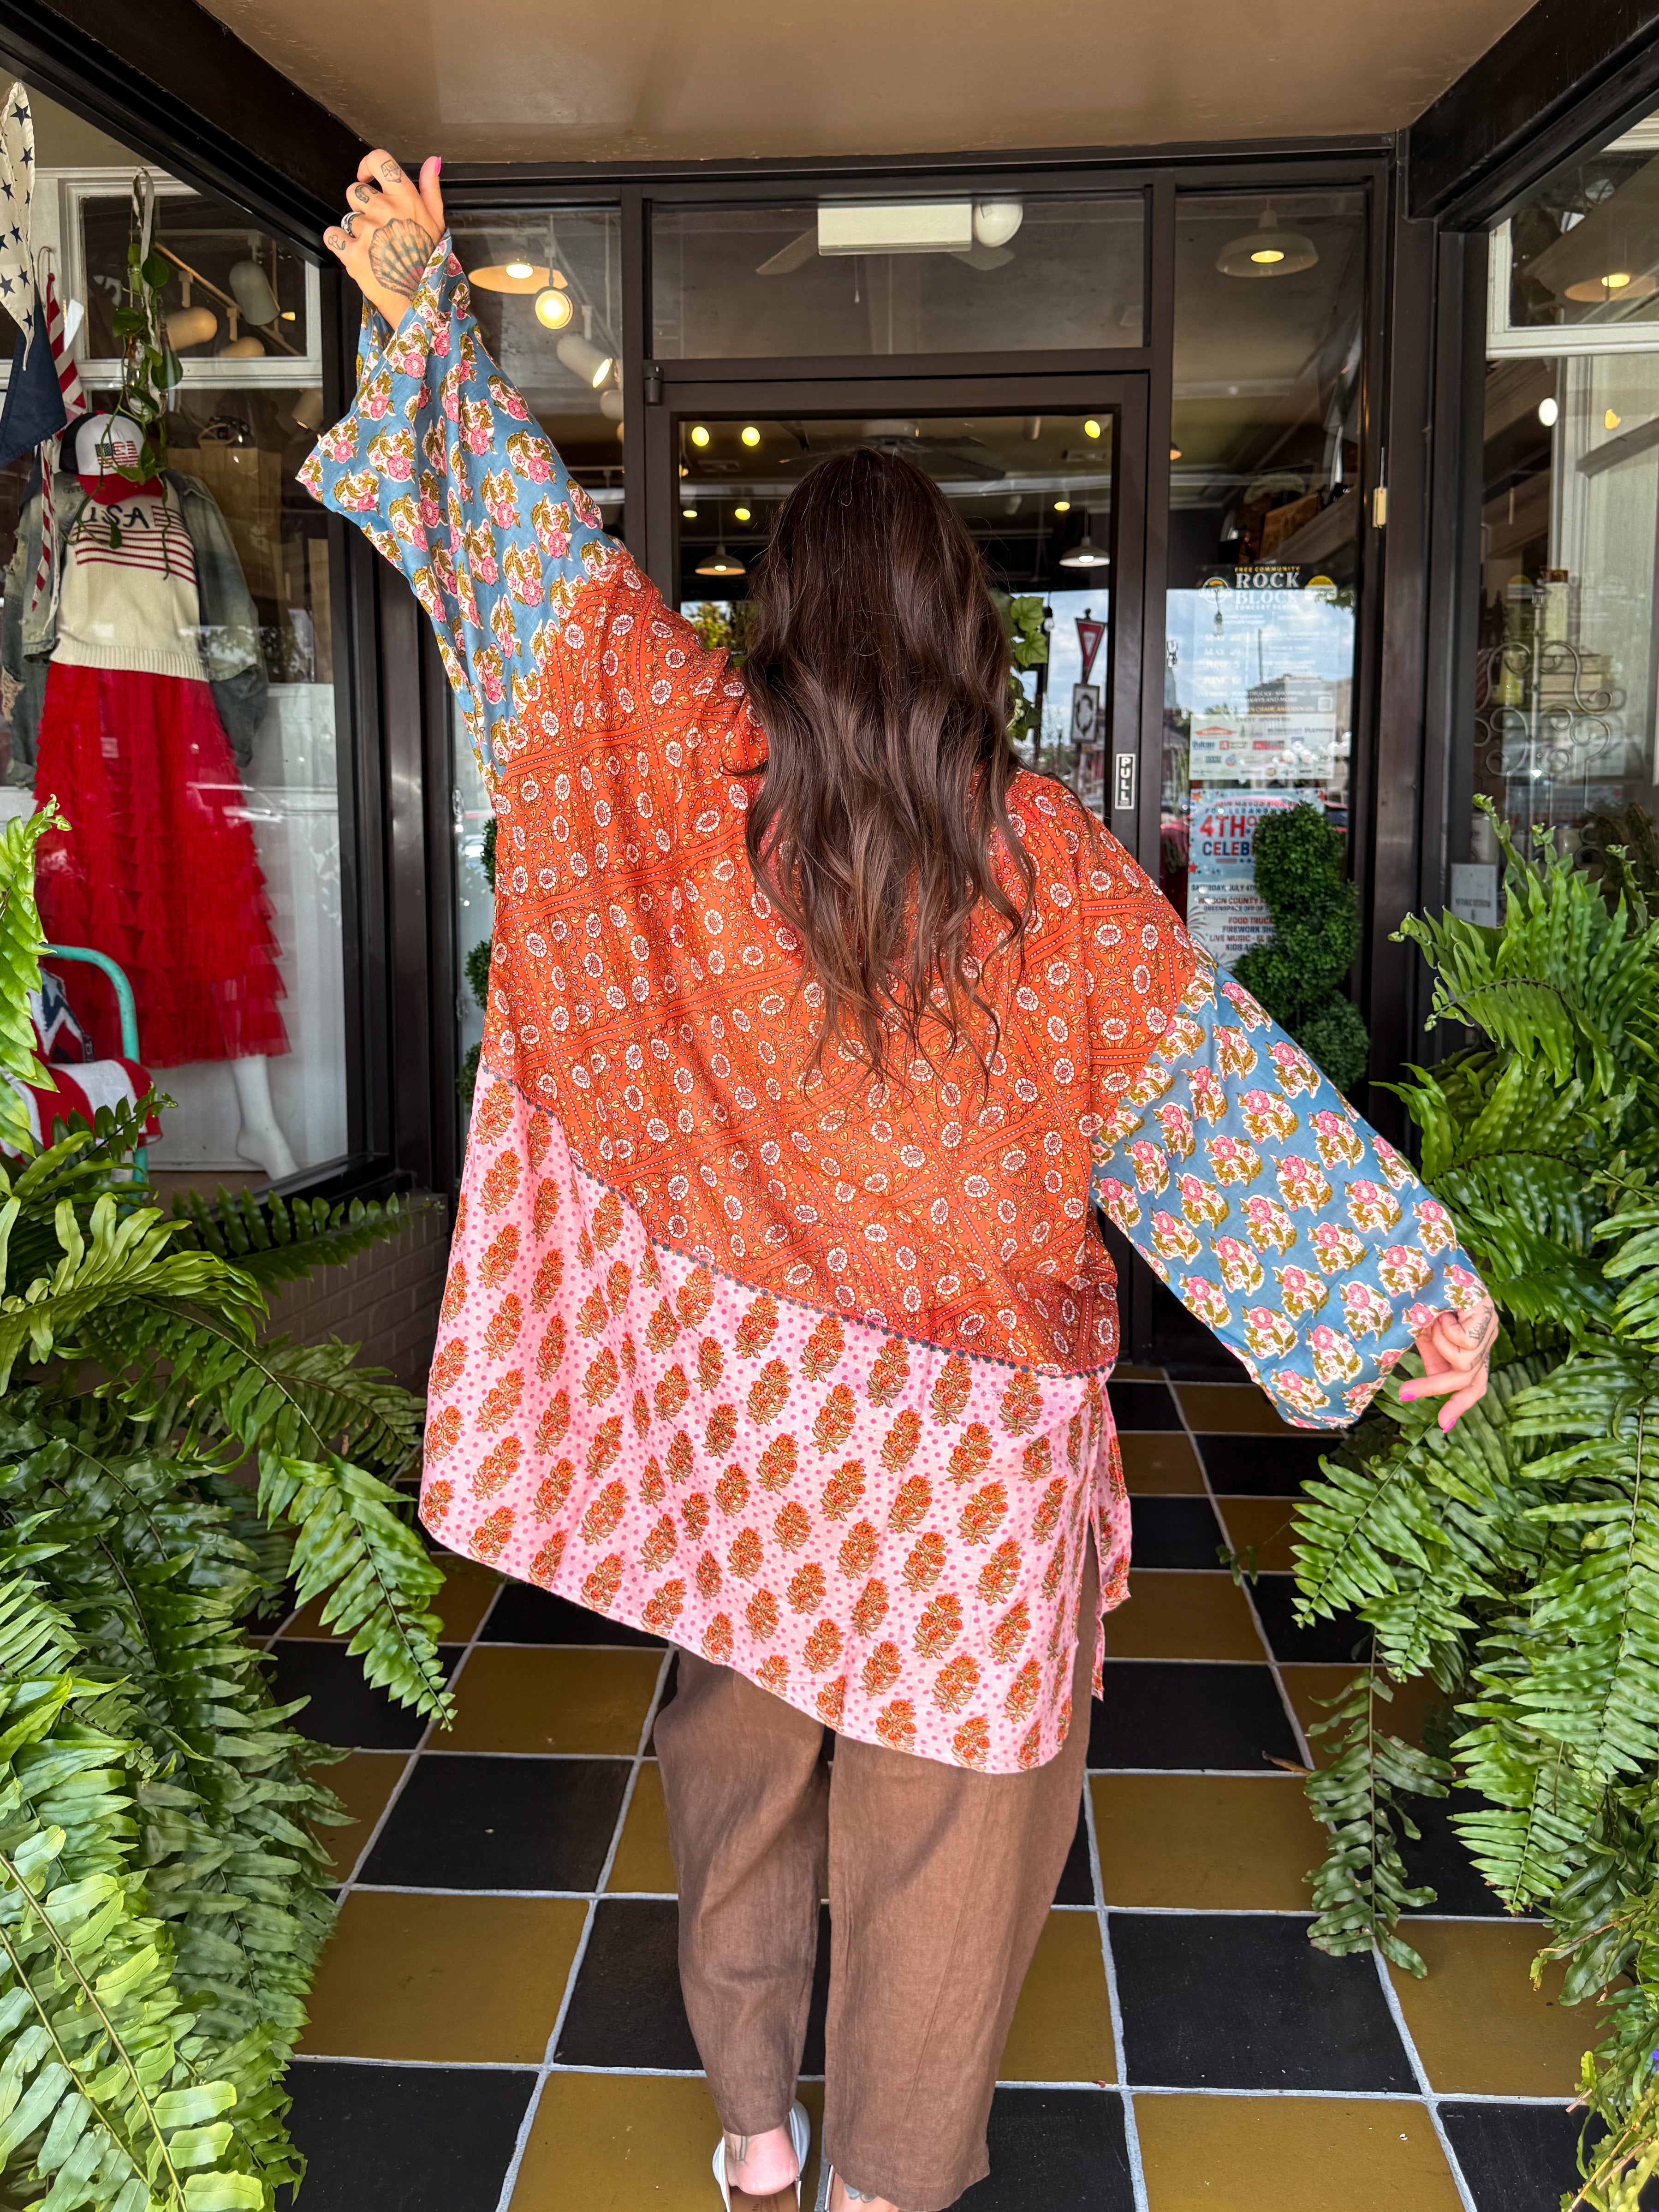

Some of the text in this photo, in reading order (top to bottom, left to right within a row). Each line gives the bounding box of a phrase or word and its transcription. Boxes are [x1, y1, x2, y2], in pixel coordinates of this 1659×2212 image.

[82, 505, 150, 529] USA
[1236, 572, 1300, 589] ROCK
[1120, 757, 1131, 801] PULL
[1200, 815, 1245, 838] 4TH
[1202, 841, 1255, 856] CELEB
